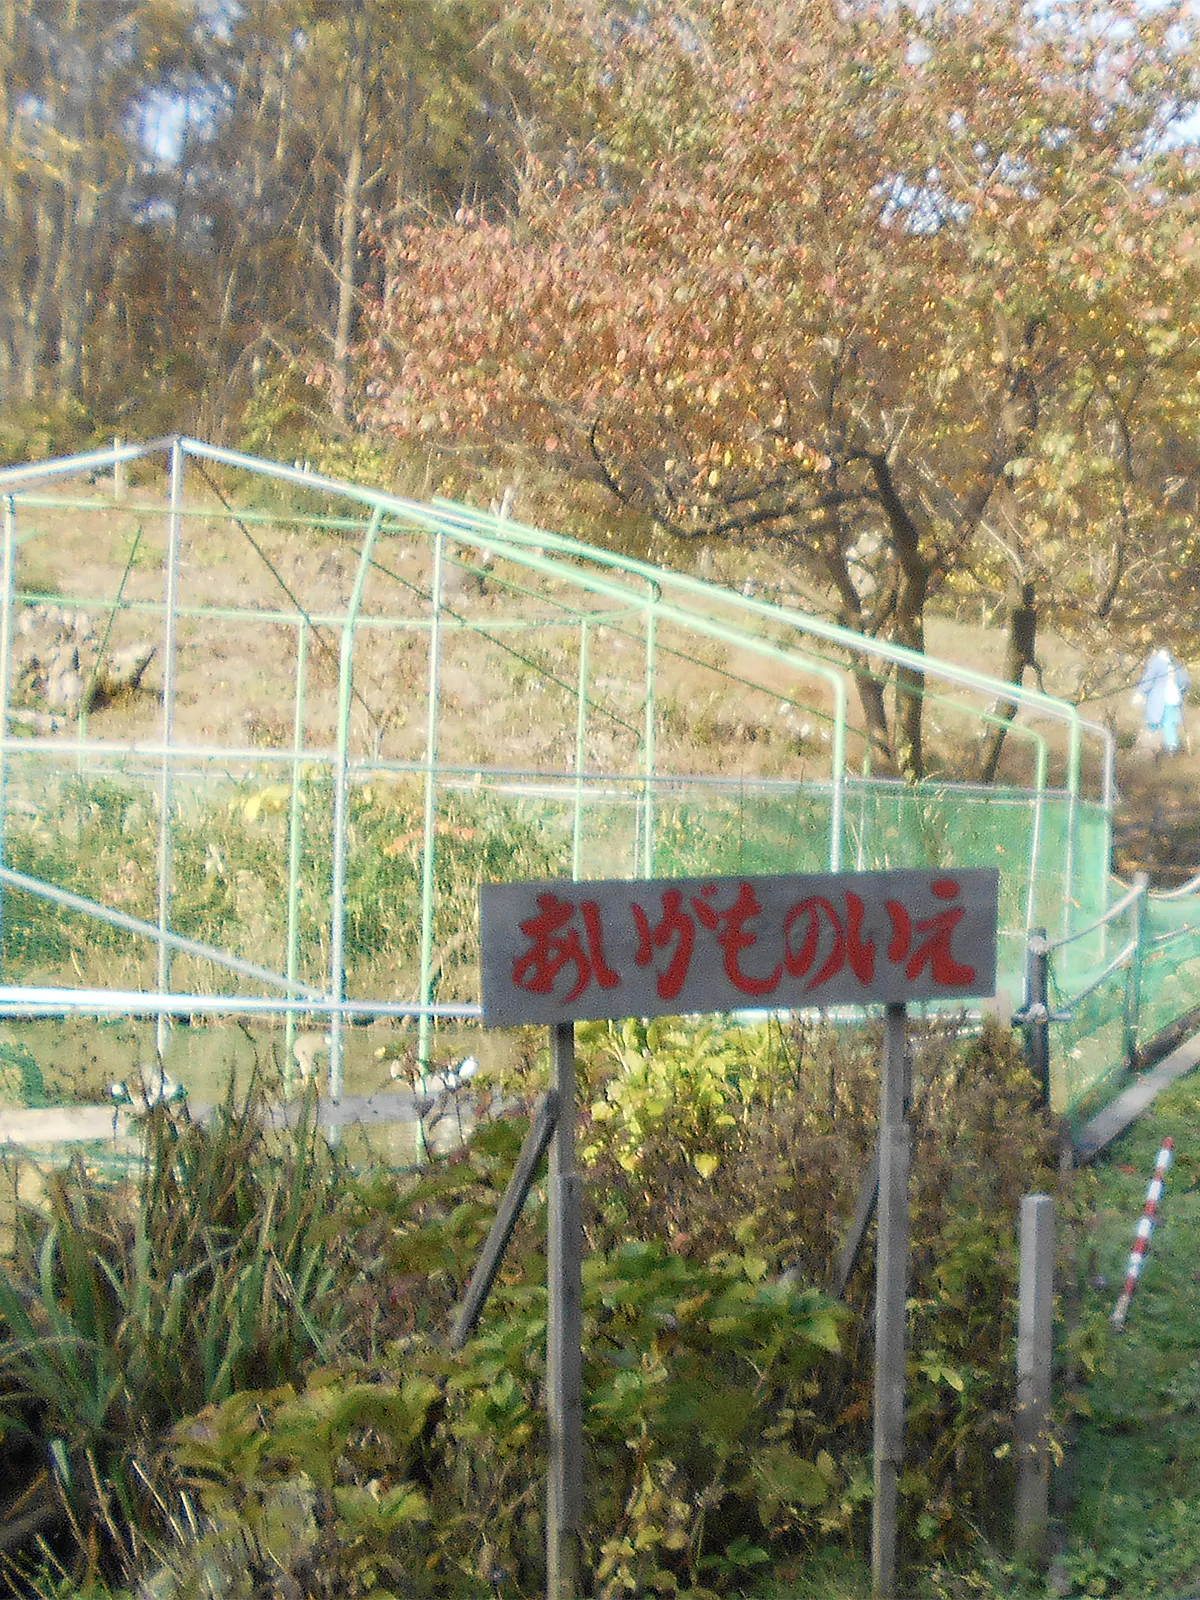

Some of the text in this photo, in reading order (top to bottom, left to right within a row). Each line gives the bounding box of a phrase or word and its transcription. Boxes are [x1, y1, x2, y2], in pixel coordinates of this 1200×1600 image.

[511, 879, 975, 1002] あいがものいえ
